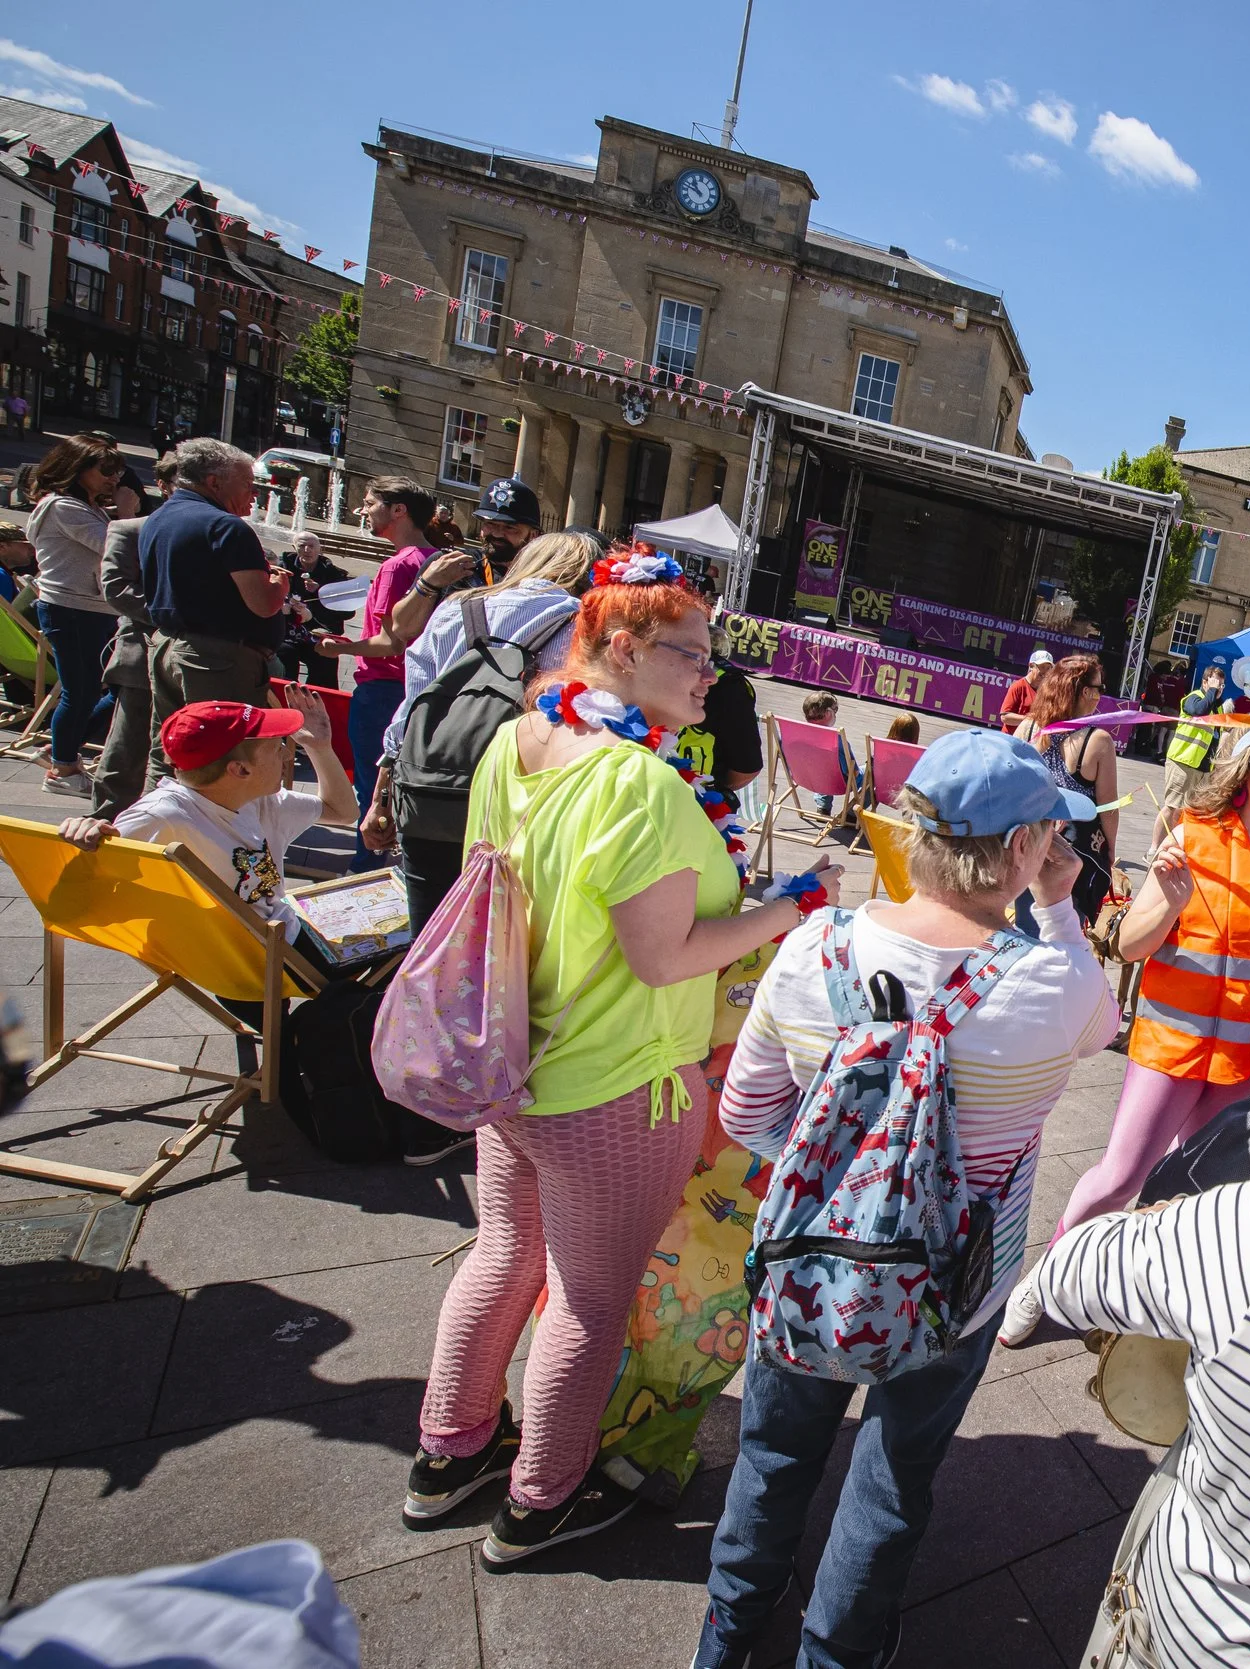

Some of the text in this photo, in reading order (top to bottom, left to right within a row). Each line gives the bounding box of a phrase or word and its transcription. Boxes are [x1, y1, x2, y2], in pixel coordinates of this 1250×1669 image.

[807, 550, 837, 568] FEST
[808, 540, 838, 556] ONE
[851, 587, 893, 611] ONE
[851, 603, 891, 626] FEST
[900, 598, 948, 616] LEARNING
[949, 610, 996, 627] DISABLED
[996, 621, 1016, 632] AND
[1017, 626, 1062, 643] AUTISTIC
[725, 613, 783, 647] ONE
[790, 628, 854, 651] LEARNING
[857, 643, 916, 666] DISABLED
[918, 657, 944, 673] AND
[946, 665, 1003, 687] AUTISTIC
